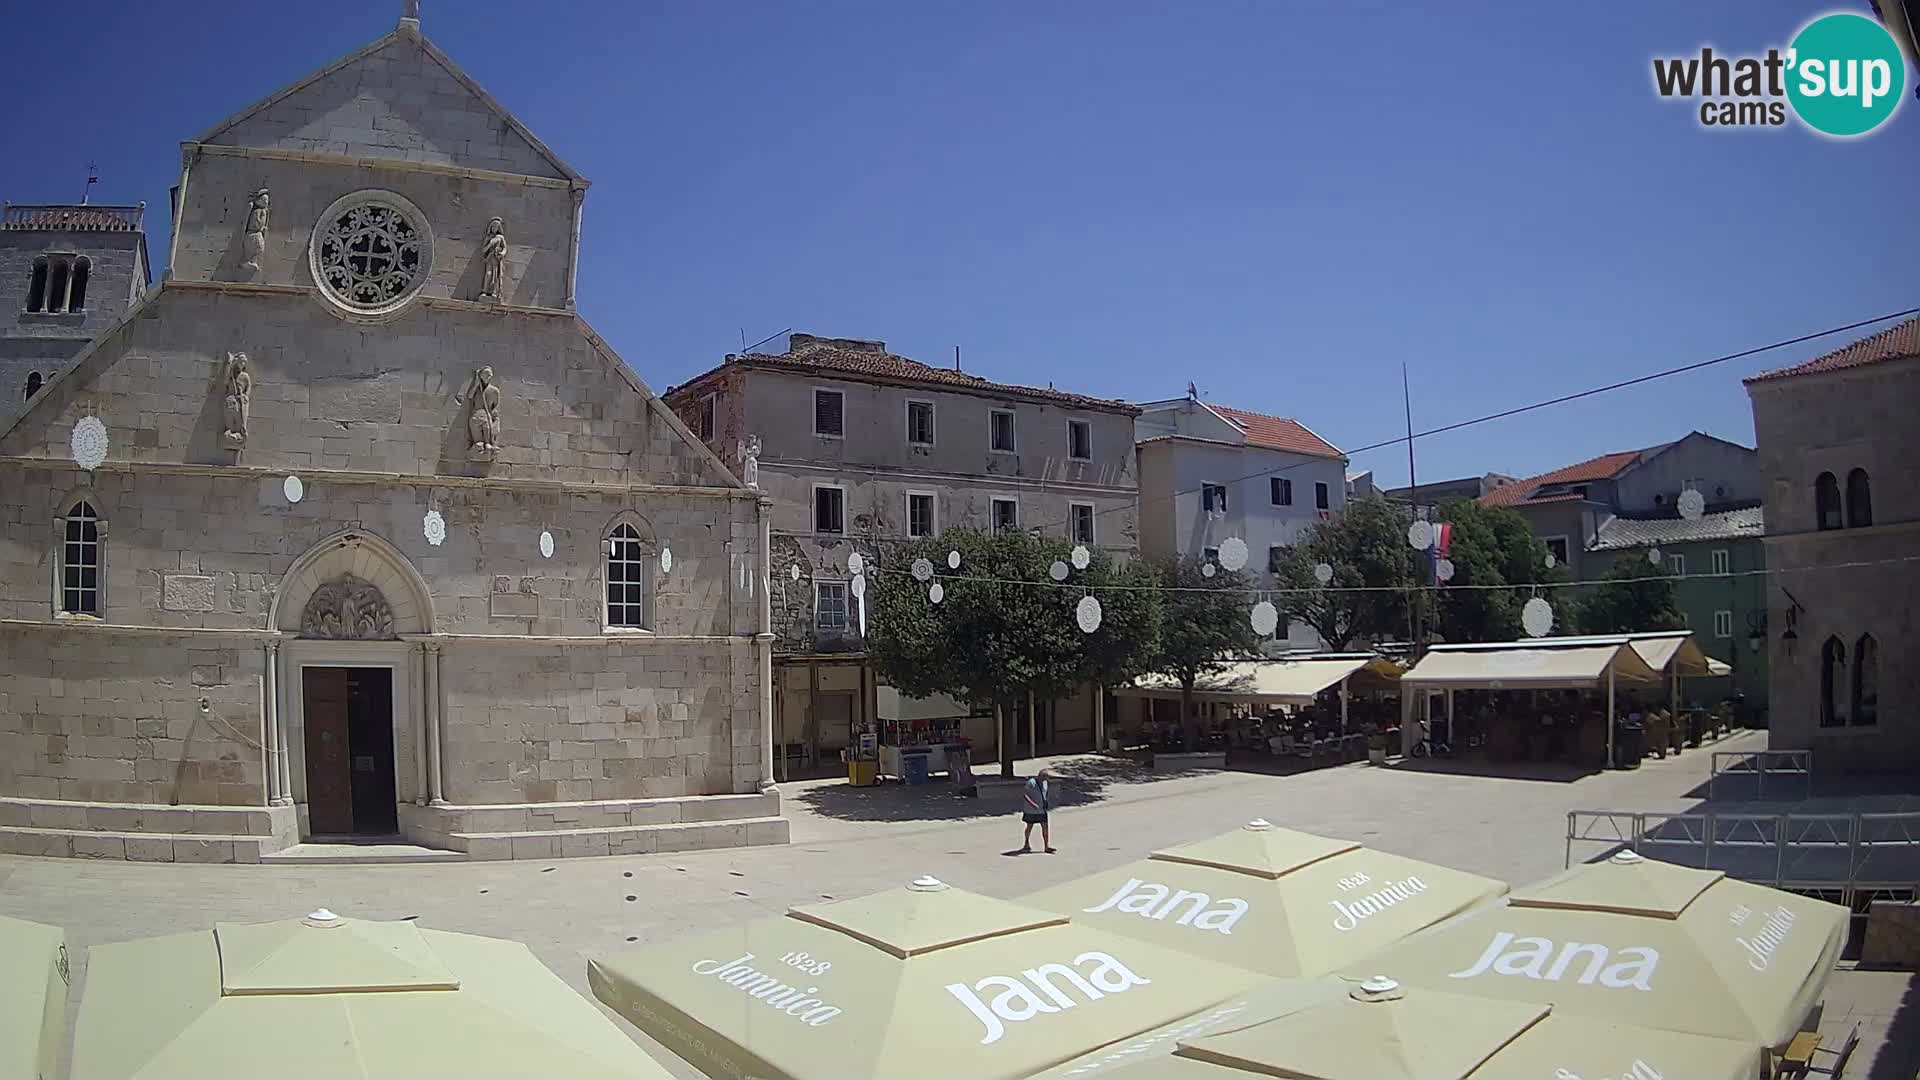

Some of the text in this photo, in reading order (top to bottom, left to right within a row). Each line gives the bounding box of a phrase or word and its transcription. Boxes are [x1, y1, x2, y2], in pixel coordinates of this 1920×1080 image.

[1082, 878, 1249, 935] Jana
[1328, 876, 1428, 930] Jamnica
[692, 951, 842, 1026] Jamnica
[778, 951, 832, 976] 1828
[1448, 932, 1659, 991] Jana
[944, 951, 1152, 1044] Jana
